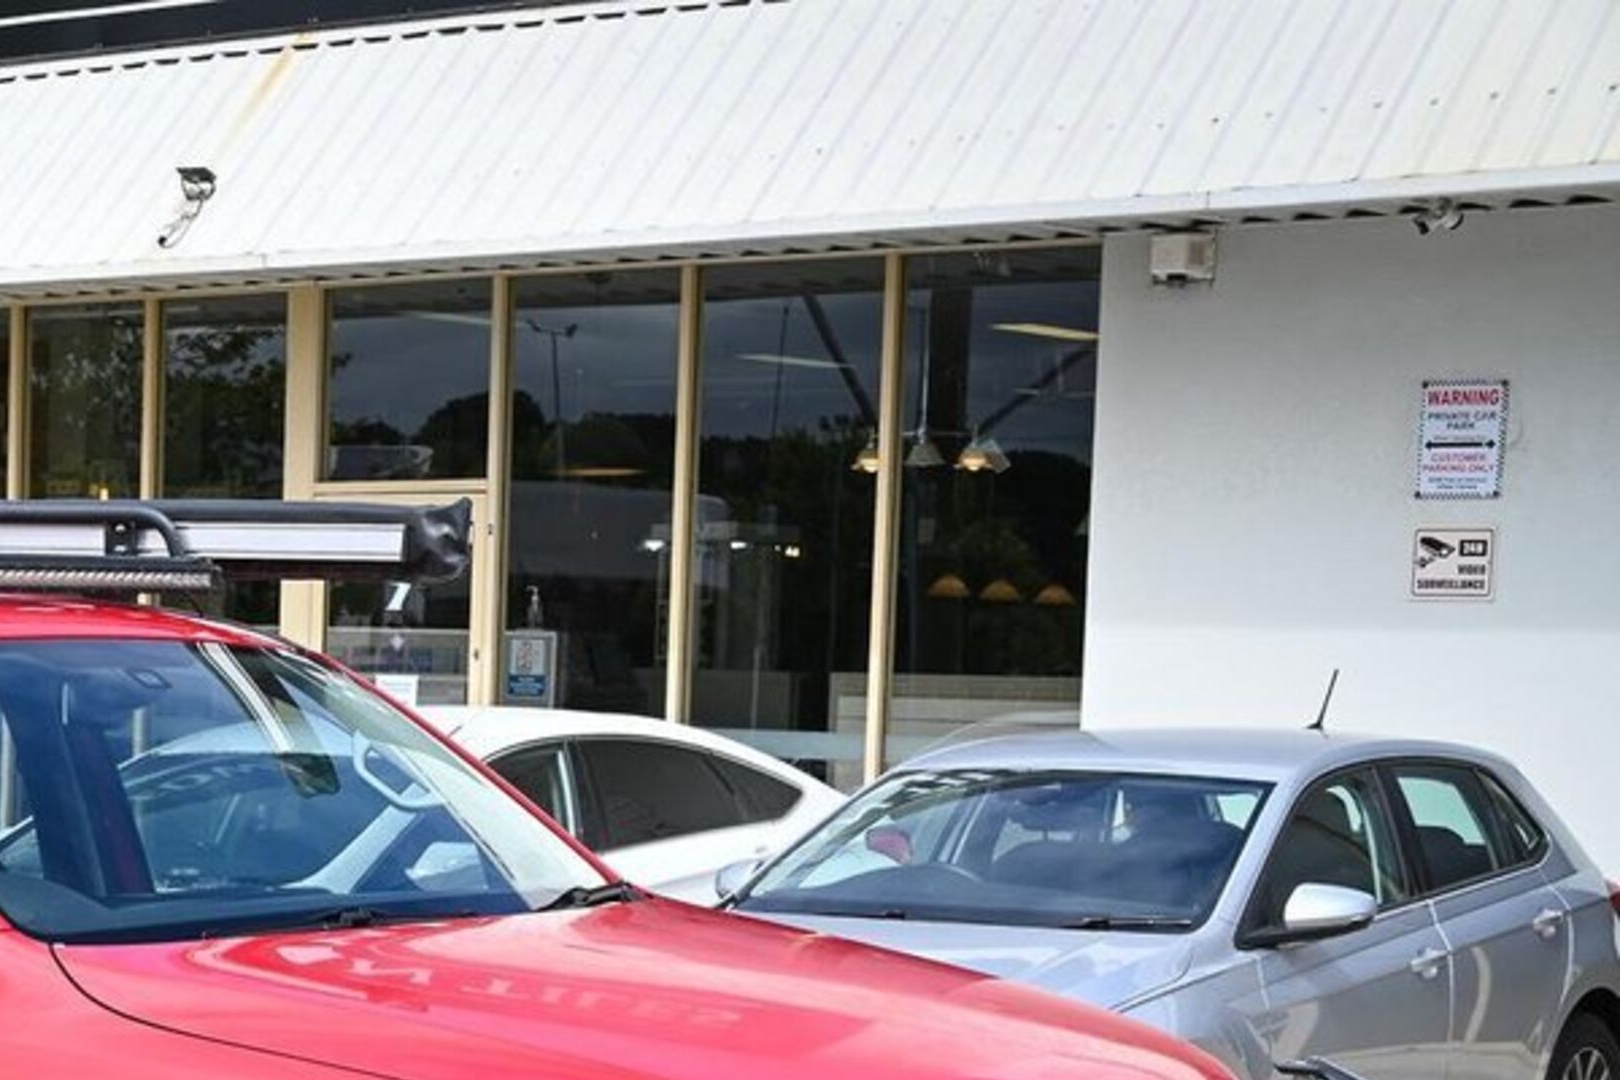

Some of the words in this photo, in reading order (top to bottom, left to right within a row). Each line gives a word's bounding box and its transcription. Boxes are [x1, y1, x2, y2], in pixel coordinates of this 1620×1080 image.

[1428, 388, 1499, 406] WARNING
[1428, 411, 1470, 422] PRIVATE
[1474, 411, 1497, 422] CAR
[1446, 422, 1475, 431] PARK
[1431, 452, 1487, 463] CUSTOMER
[1423, 464, 1467, 474] PARKING
[1469, 463, 1495, 474] ONLY
